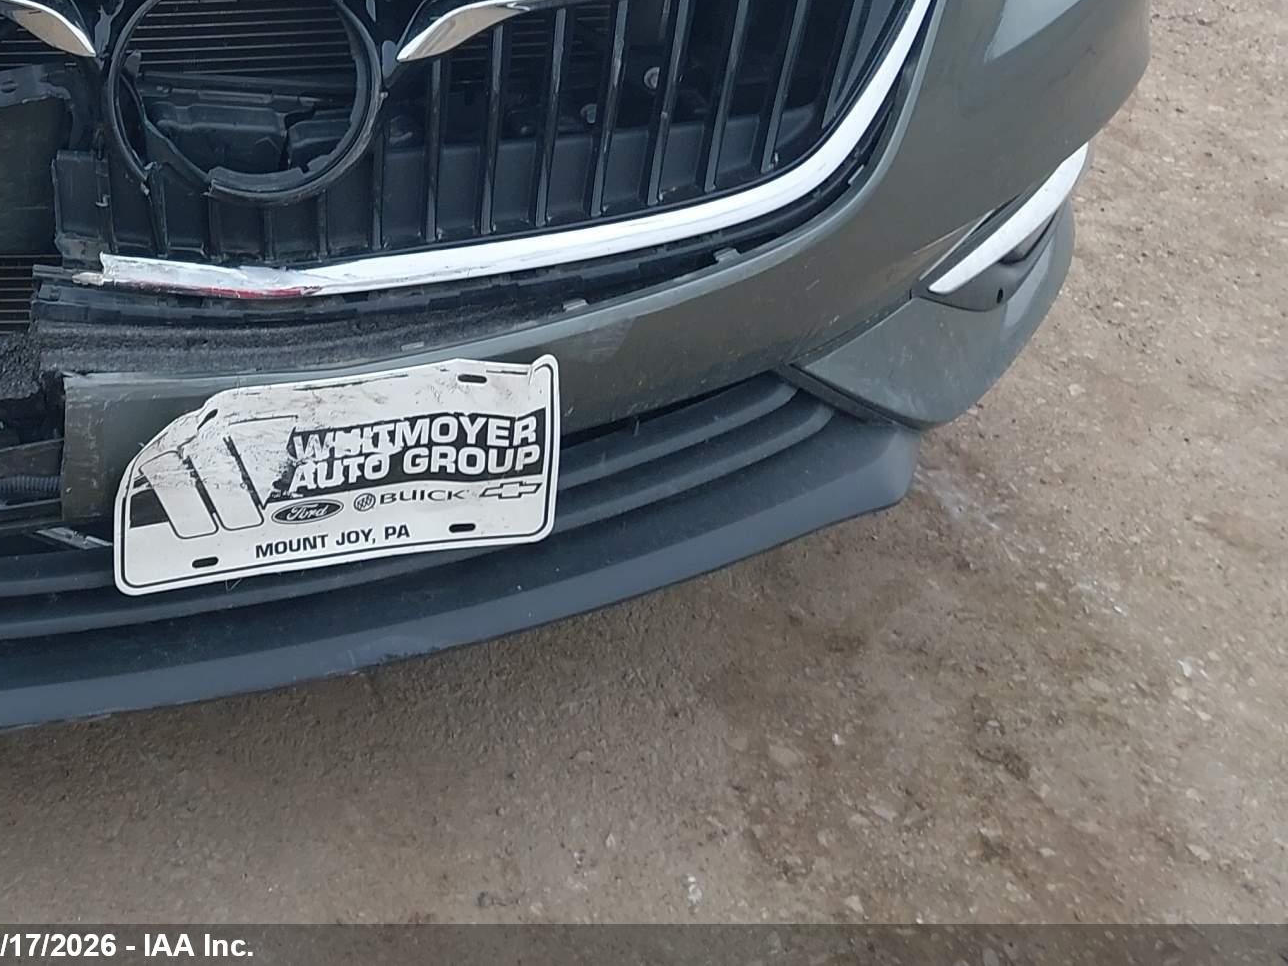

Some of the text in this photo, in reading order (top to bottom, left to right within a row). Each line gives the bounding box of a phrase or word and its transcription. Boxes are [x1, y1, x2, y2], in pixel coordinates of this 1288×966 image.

[289, 444, 541, 493] AUTO GROUP
[379, 489, 464, 505] BUICK
[285, 503, 329, 522] Ford
[255, 523, 411, 558] MOUNT JOY, PA
